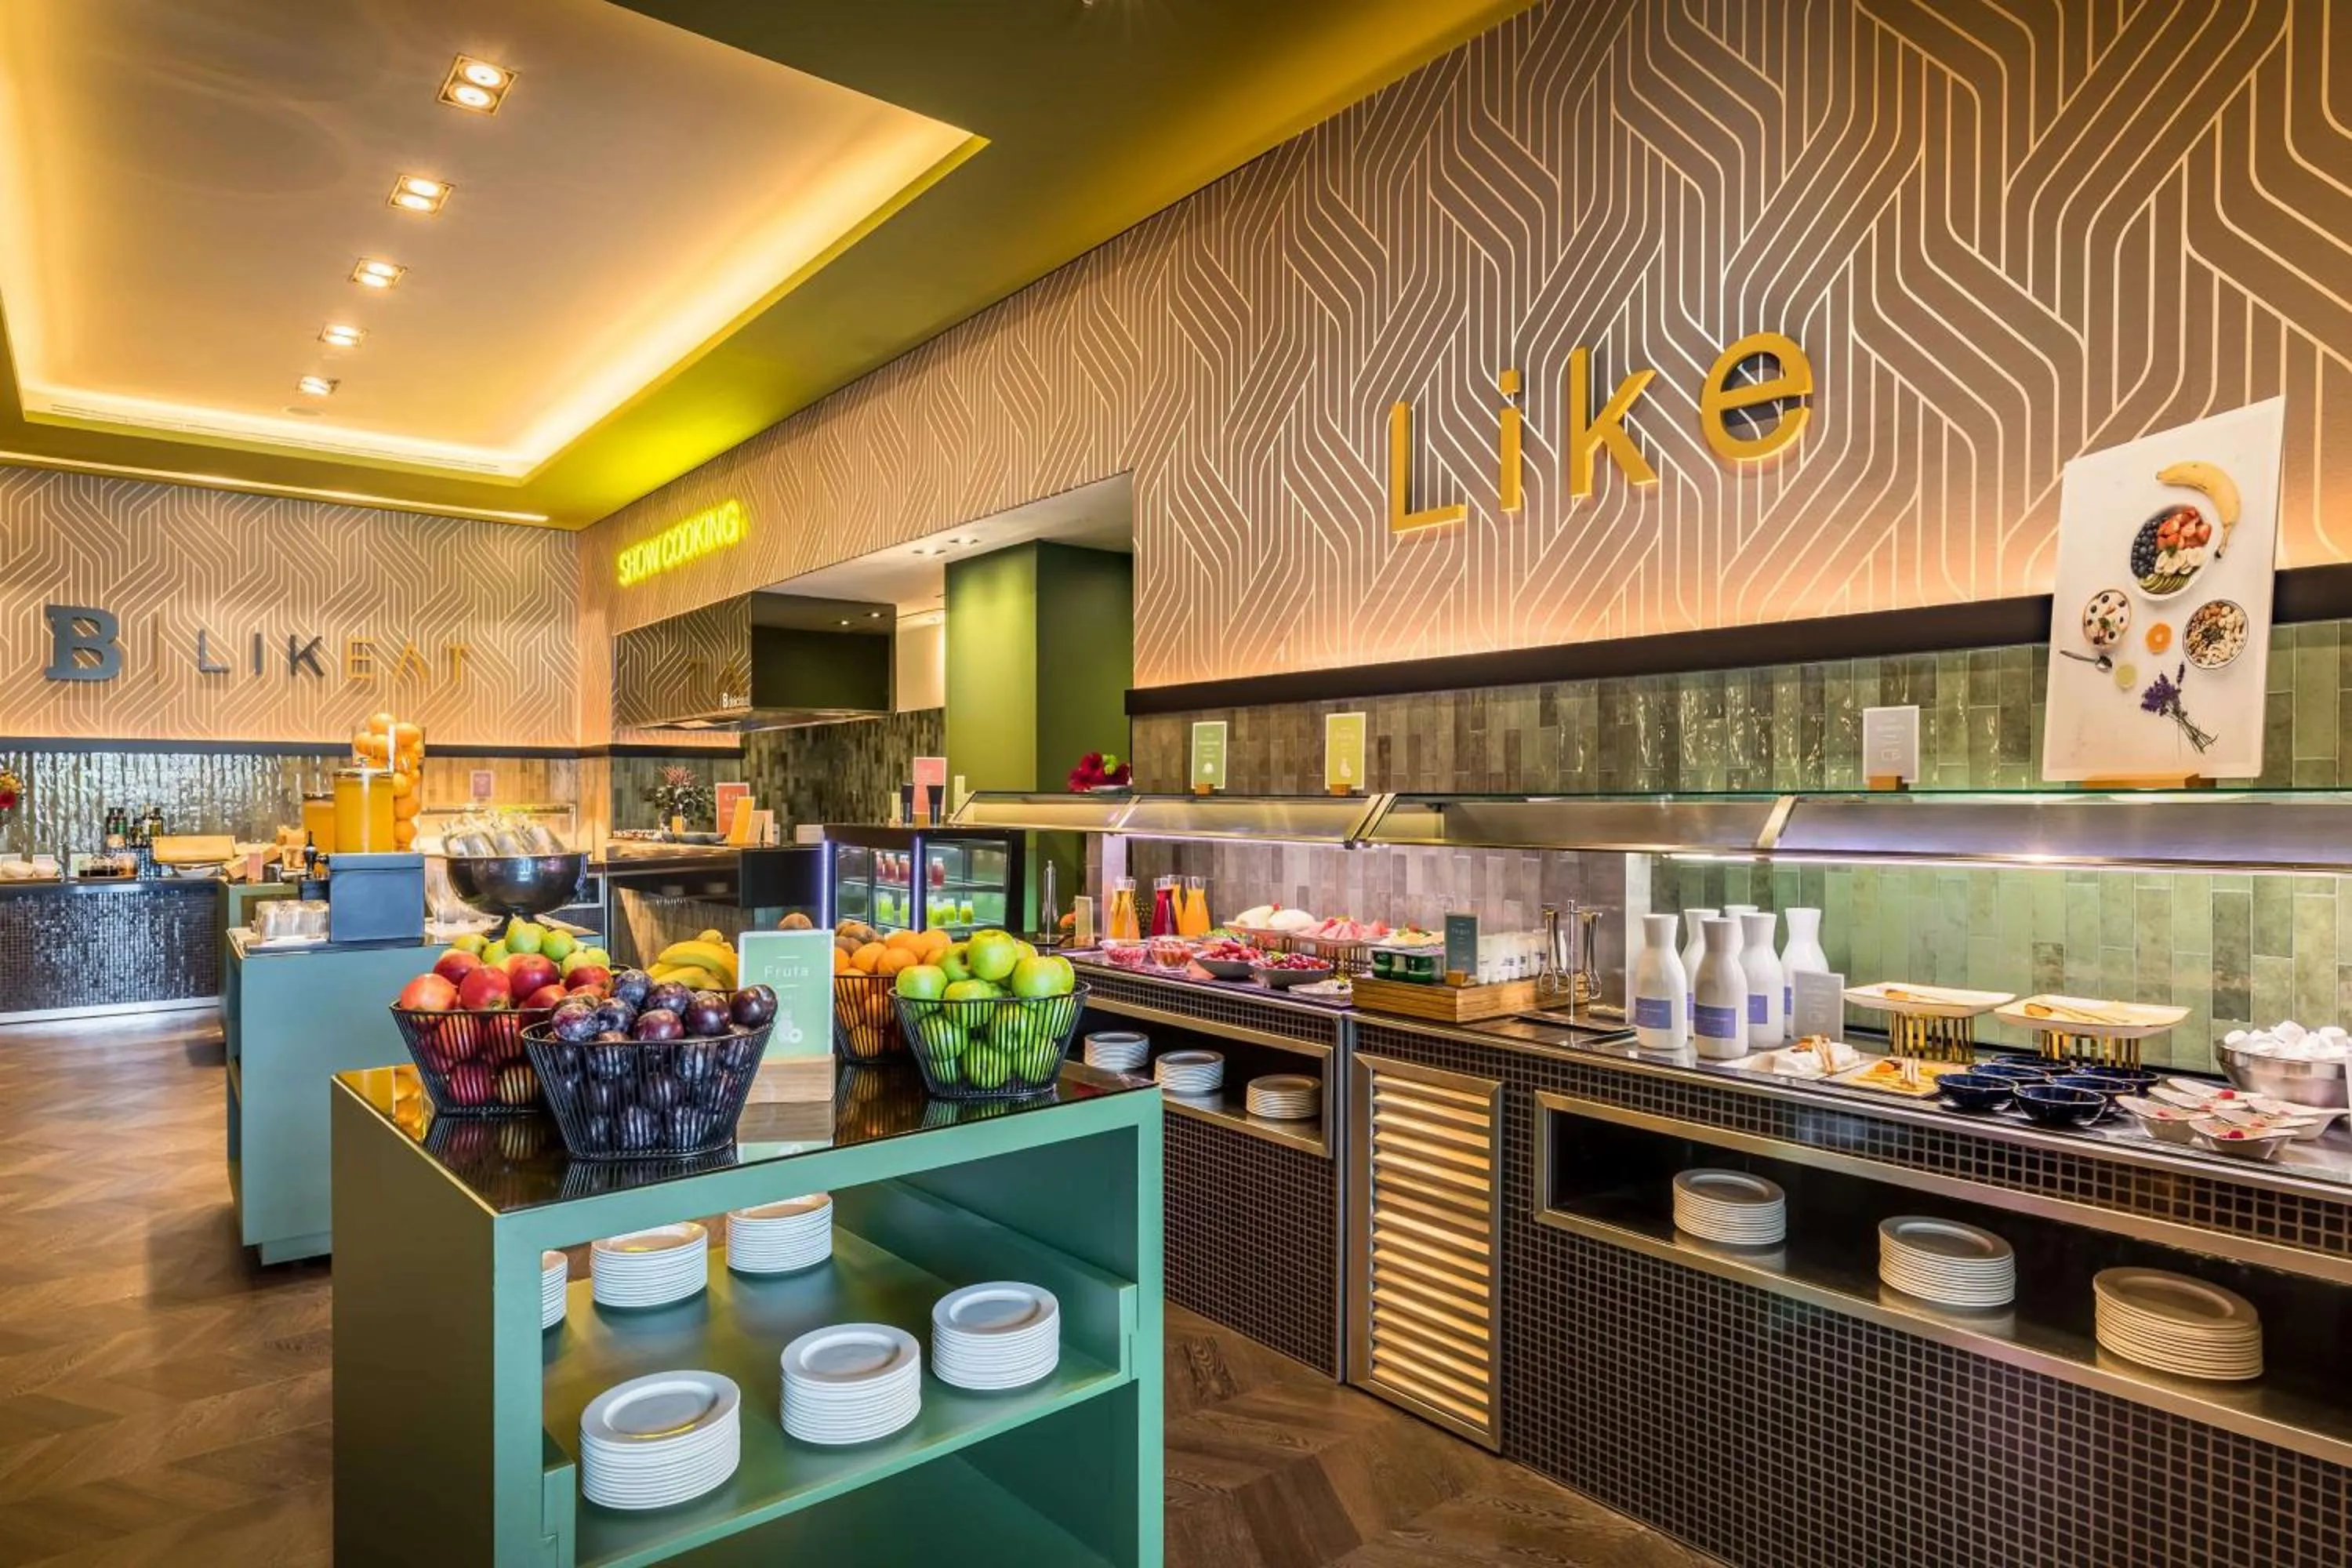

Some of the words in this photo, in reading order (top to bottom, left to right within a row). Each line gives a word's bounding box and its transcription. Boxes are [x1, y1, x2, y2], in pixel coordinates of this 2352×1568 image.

[1391, 332, 1813, 534] Like
[618, 534, 661, 586] SHOW
[662, 499, 740, 568] COOKING
[44, 604, 122, 681] B
[198, 629, 470, 683] LIKEAT
[764, 964, 809, 978] Fruta
